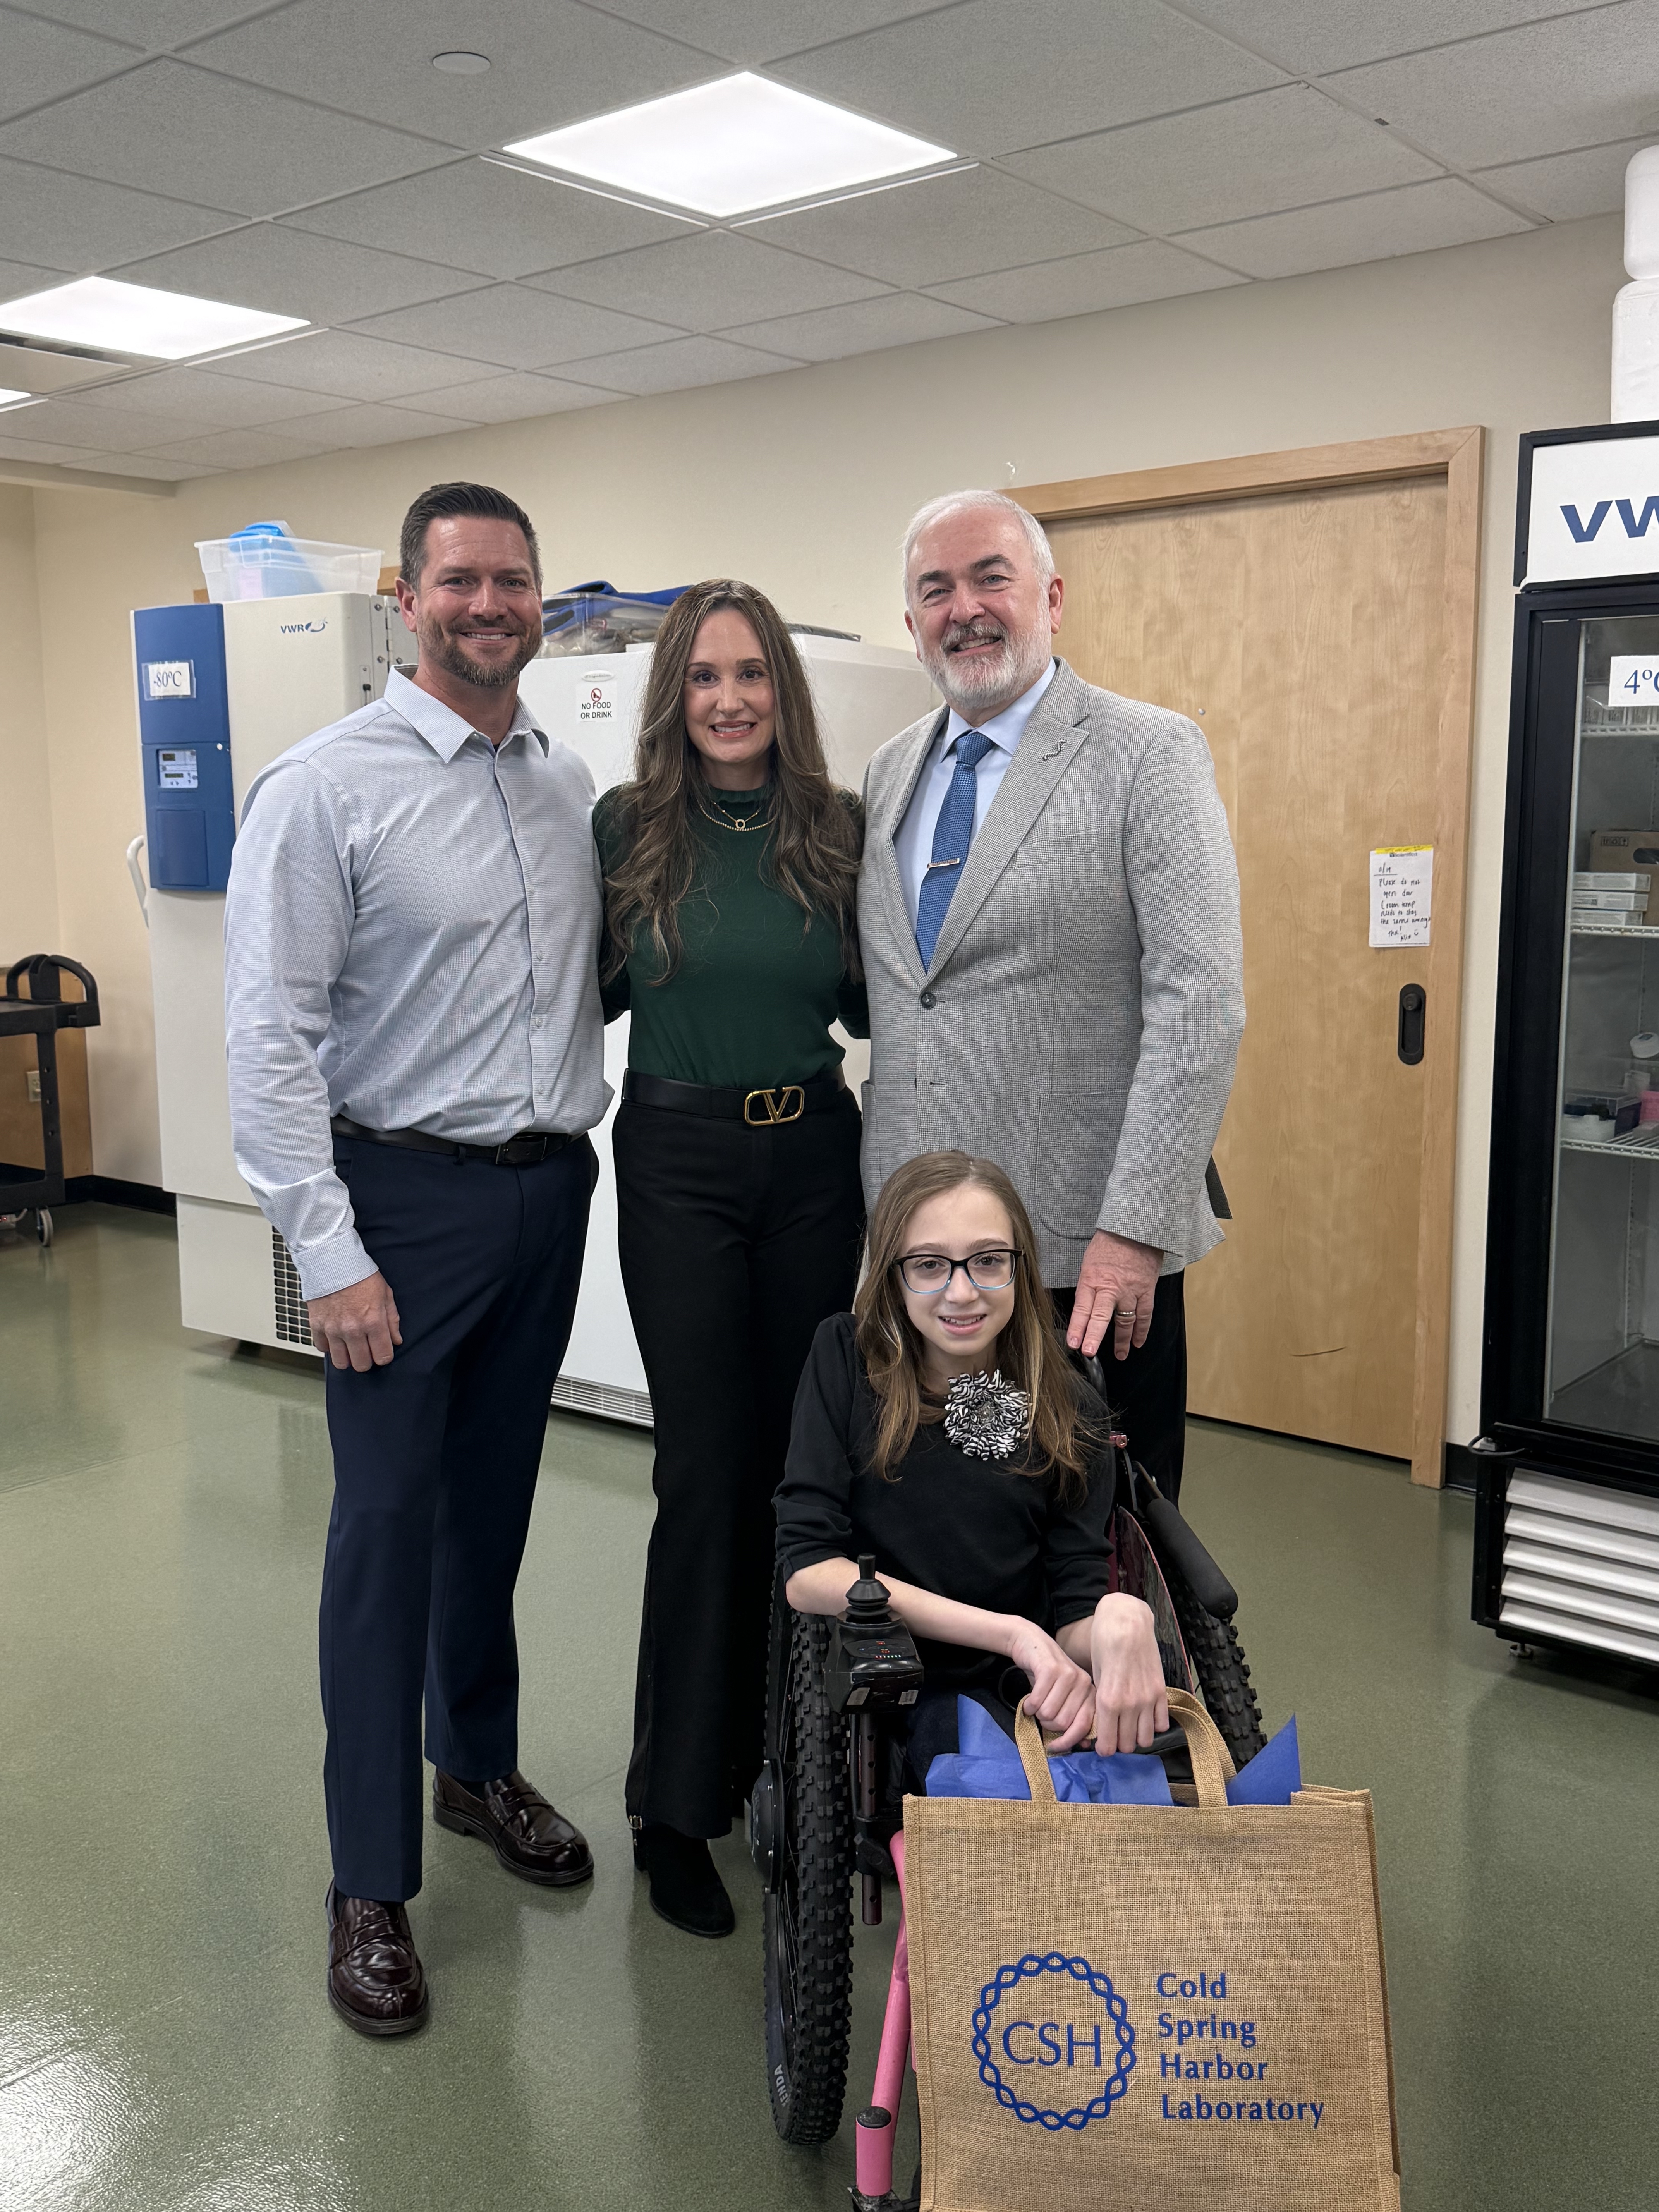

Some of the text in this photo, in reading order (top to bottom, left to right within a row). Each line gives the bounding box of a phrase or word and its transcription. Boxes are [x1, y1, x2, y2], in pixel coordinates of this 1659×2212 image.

[280, 624, 304, 634] VWR
[1624, 669, 1659, 694] 4°
[1156, 1973, 1226, 1999] Cold
[1158, 2013, 1256, 2048] Spring
[1003, 2021, 1101, 2067] CSH
[1160, 2054, 1267, 2080] Harbor
[1161, 2094, 1324, 2128] Laboratory
